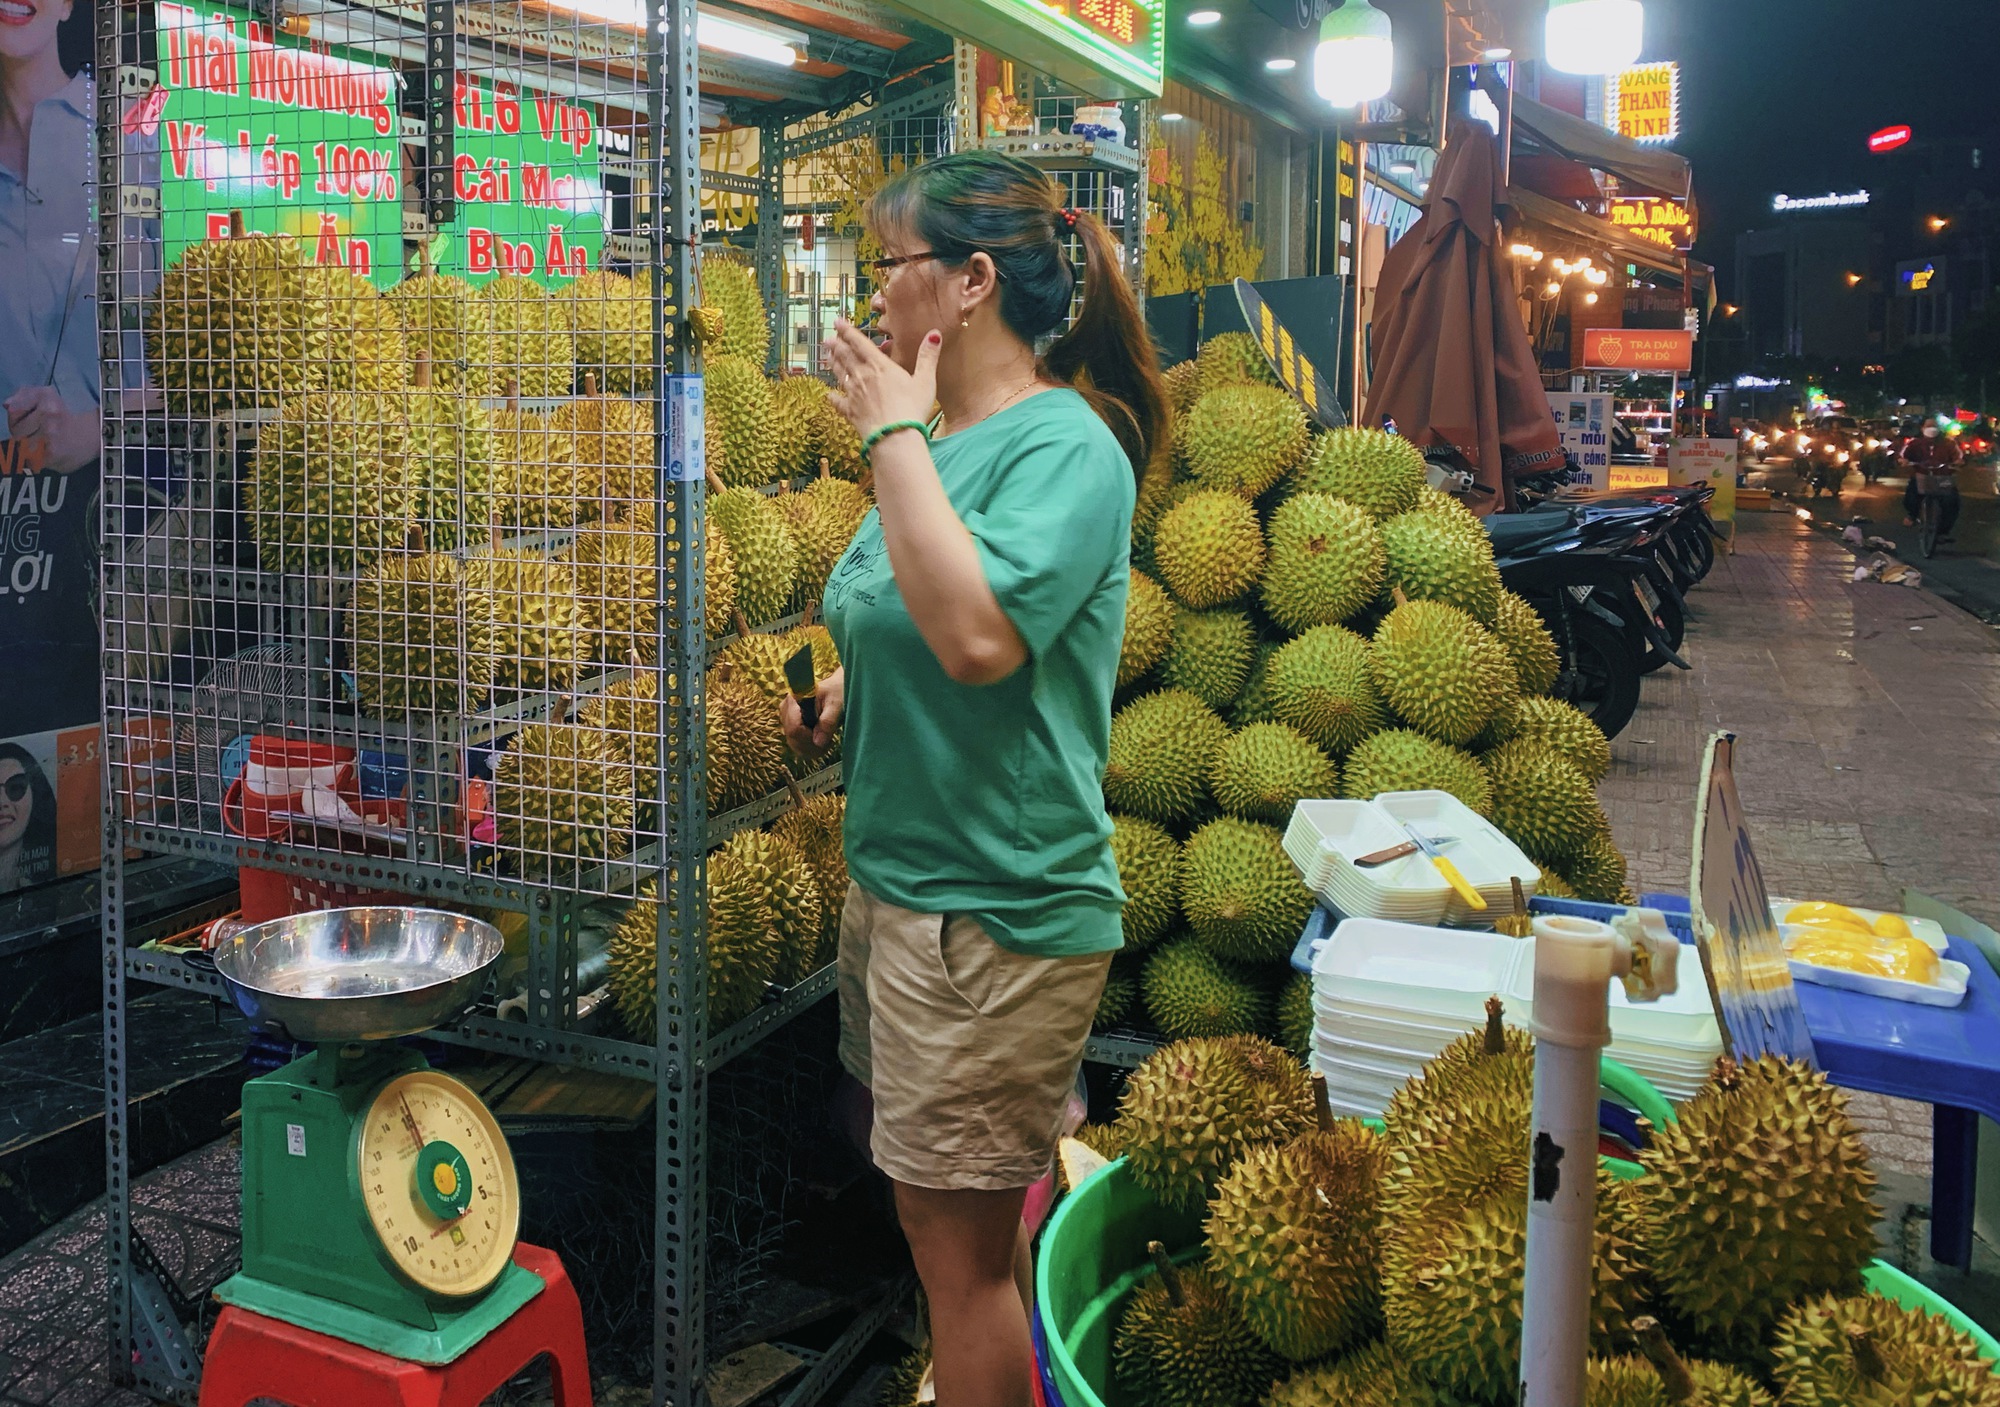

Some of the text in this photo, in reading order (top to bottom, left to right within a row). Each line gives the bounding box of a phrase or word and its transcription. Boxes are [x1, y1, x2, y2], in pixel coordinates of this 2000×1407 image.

[161, 2, 239, 97] Thái
[1624, 69, 1670, 87] VÀNG
[166, 121, 223, 192] Ví
[313, 142, 396, 201] 100%
[1773, 189, 1870, 209] Sacombank
[315, 212, 372, 277] Ăn
[546, 224, 588, 279] Ăn
[373, 1184, 384, 1196] 12
[477, 1184, 488, 1200] 5
[384, 1217, 394, 1230] 11
[403, 1235, 419, 1256] 10
